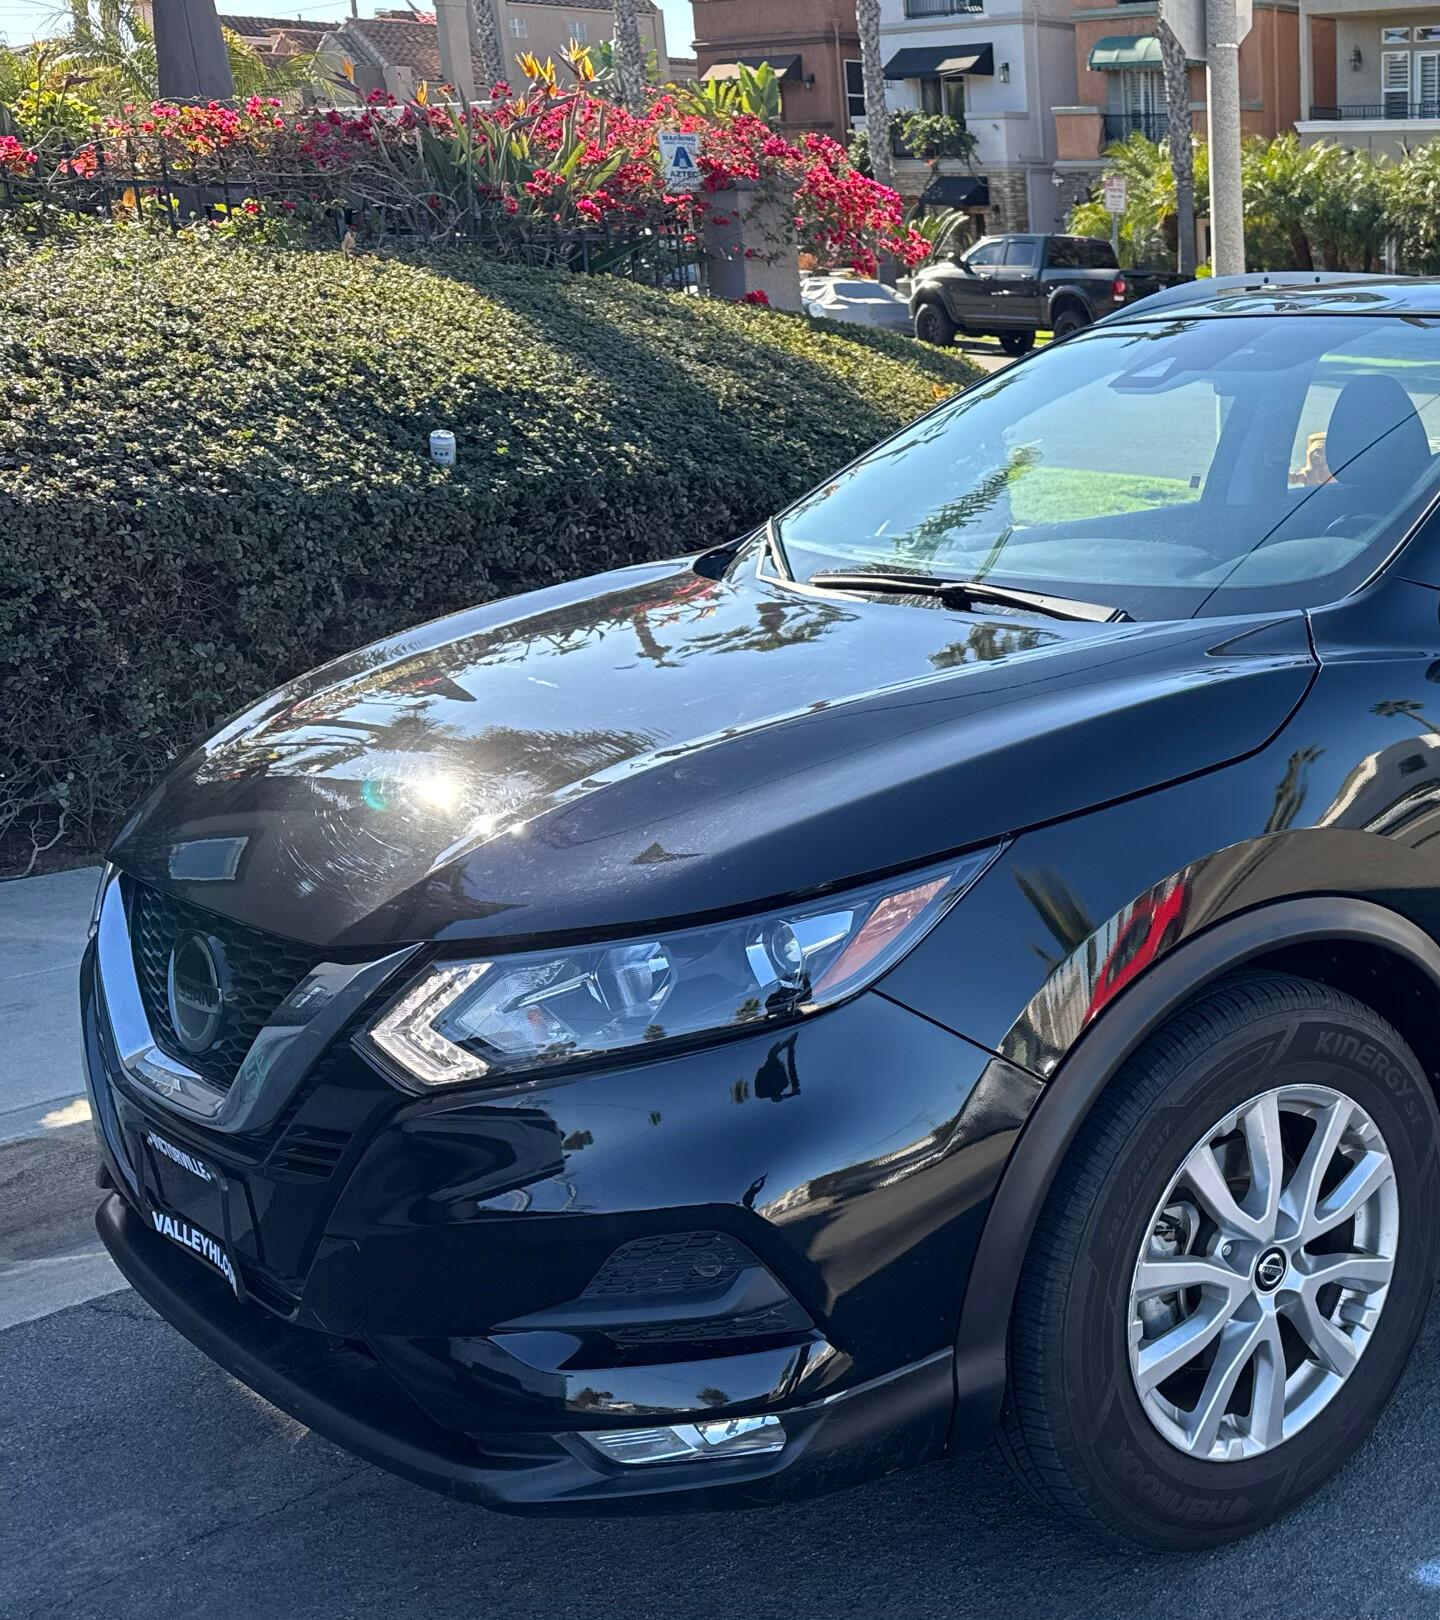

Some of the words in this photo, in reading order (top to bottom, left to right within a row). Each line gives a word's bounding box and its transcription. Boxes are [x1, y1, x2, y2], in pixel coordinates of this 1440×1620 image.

[670, 170, 698, 178] AZTEC
[1315, 1031, 1416, 1097] KINERGY
[1404, 1101, 1425, 1124] ST
